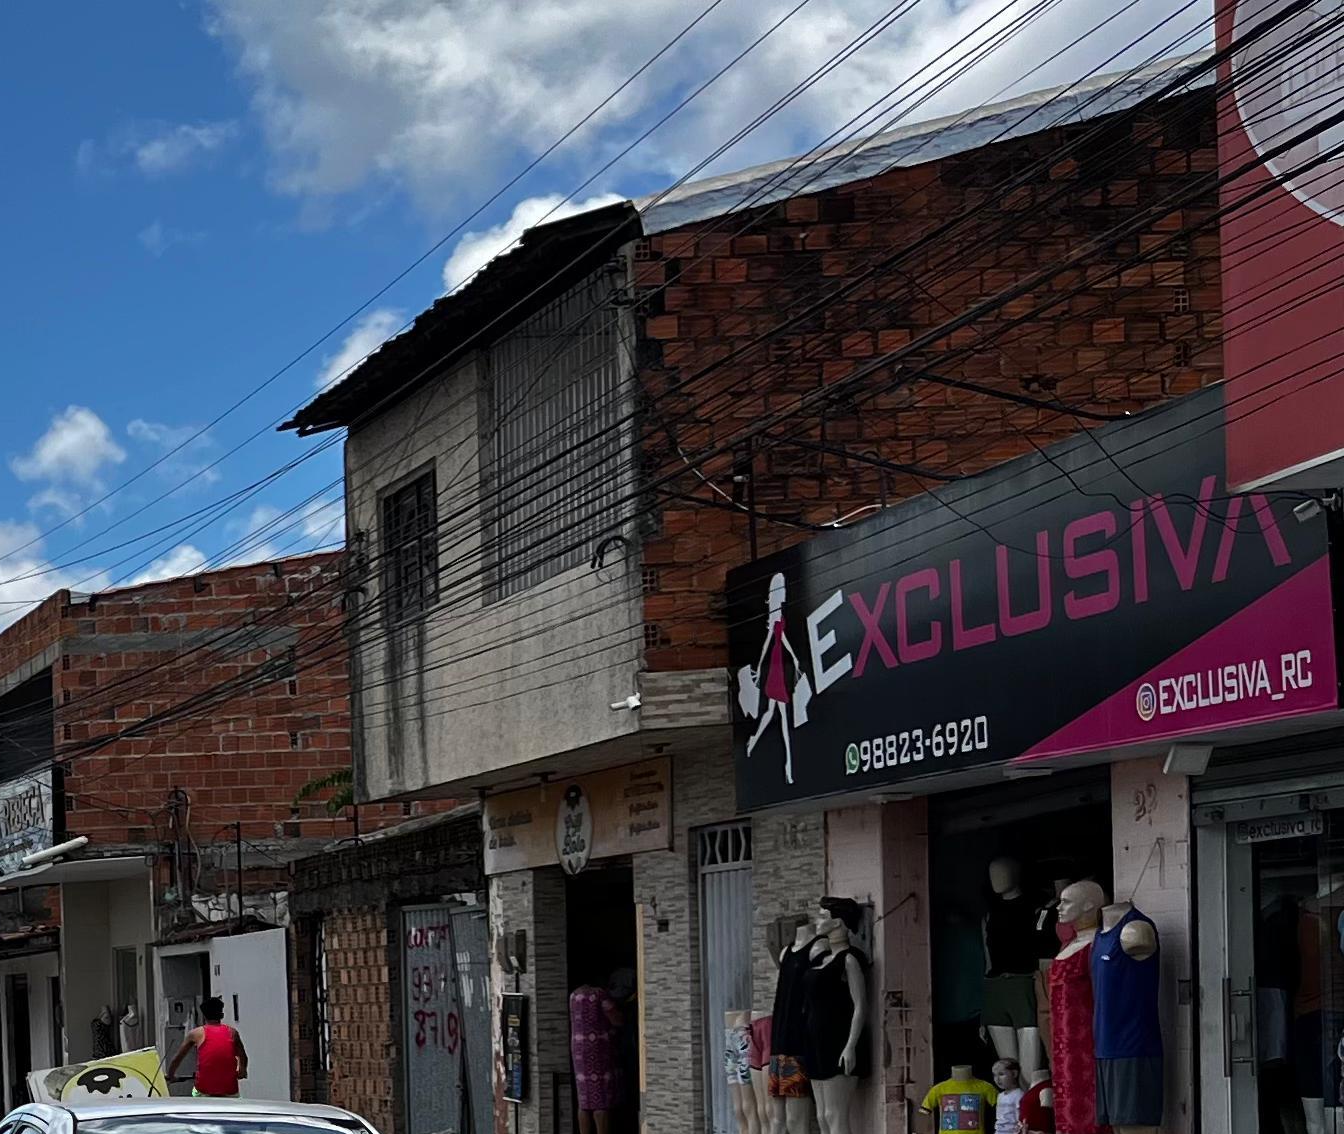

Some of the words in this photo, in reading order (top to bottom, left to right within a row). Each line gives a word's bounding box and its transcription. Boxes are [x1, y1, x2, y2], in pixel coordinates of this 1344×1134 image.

[807, 475, 1291, 695] EXCLUSIVA
[1159, 650, 1312, 715] EXCLUSIVA_RC
[860, 716, 988, 771] 98823-6920
